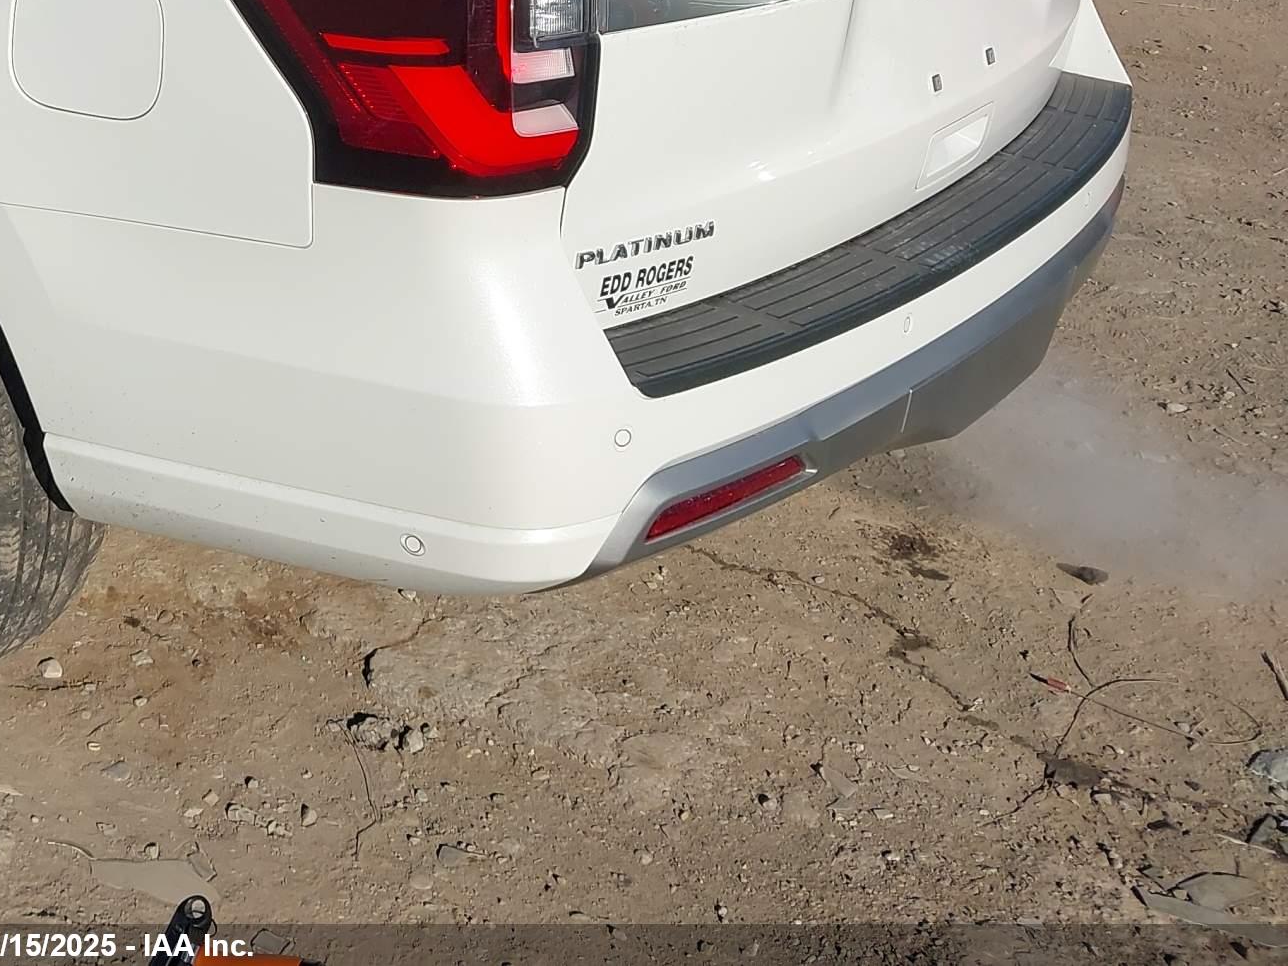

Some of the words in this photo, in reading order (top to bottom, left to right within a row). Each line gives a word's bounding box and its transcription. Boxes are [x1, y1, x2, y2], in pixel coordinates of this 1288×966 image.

[575, 220, 715, 270] PLATINUM
[600, 272, 632, 297] EDD
[636, 256, 694, 288] ROGERS
[605, 290, 655, 309] VALLEY
[660, 281, 687, 294] FORD
